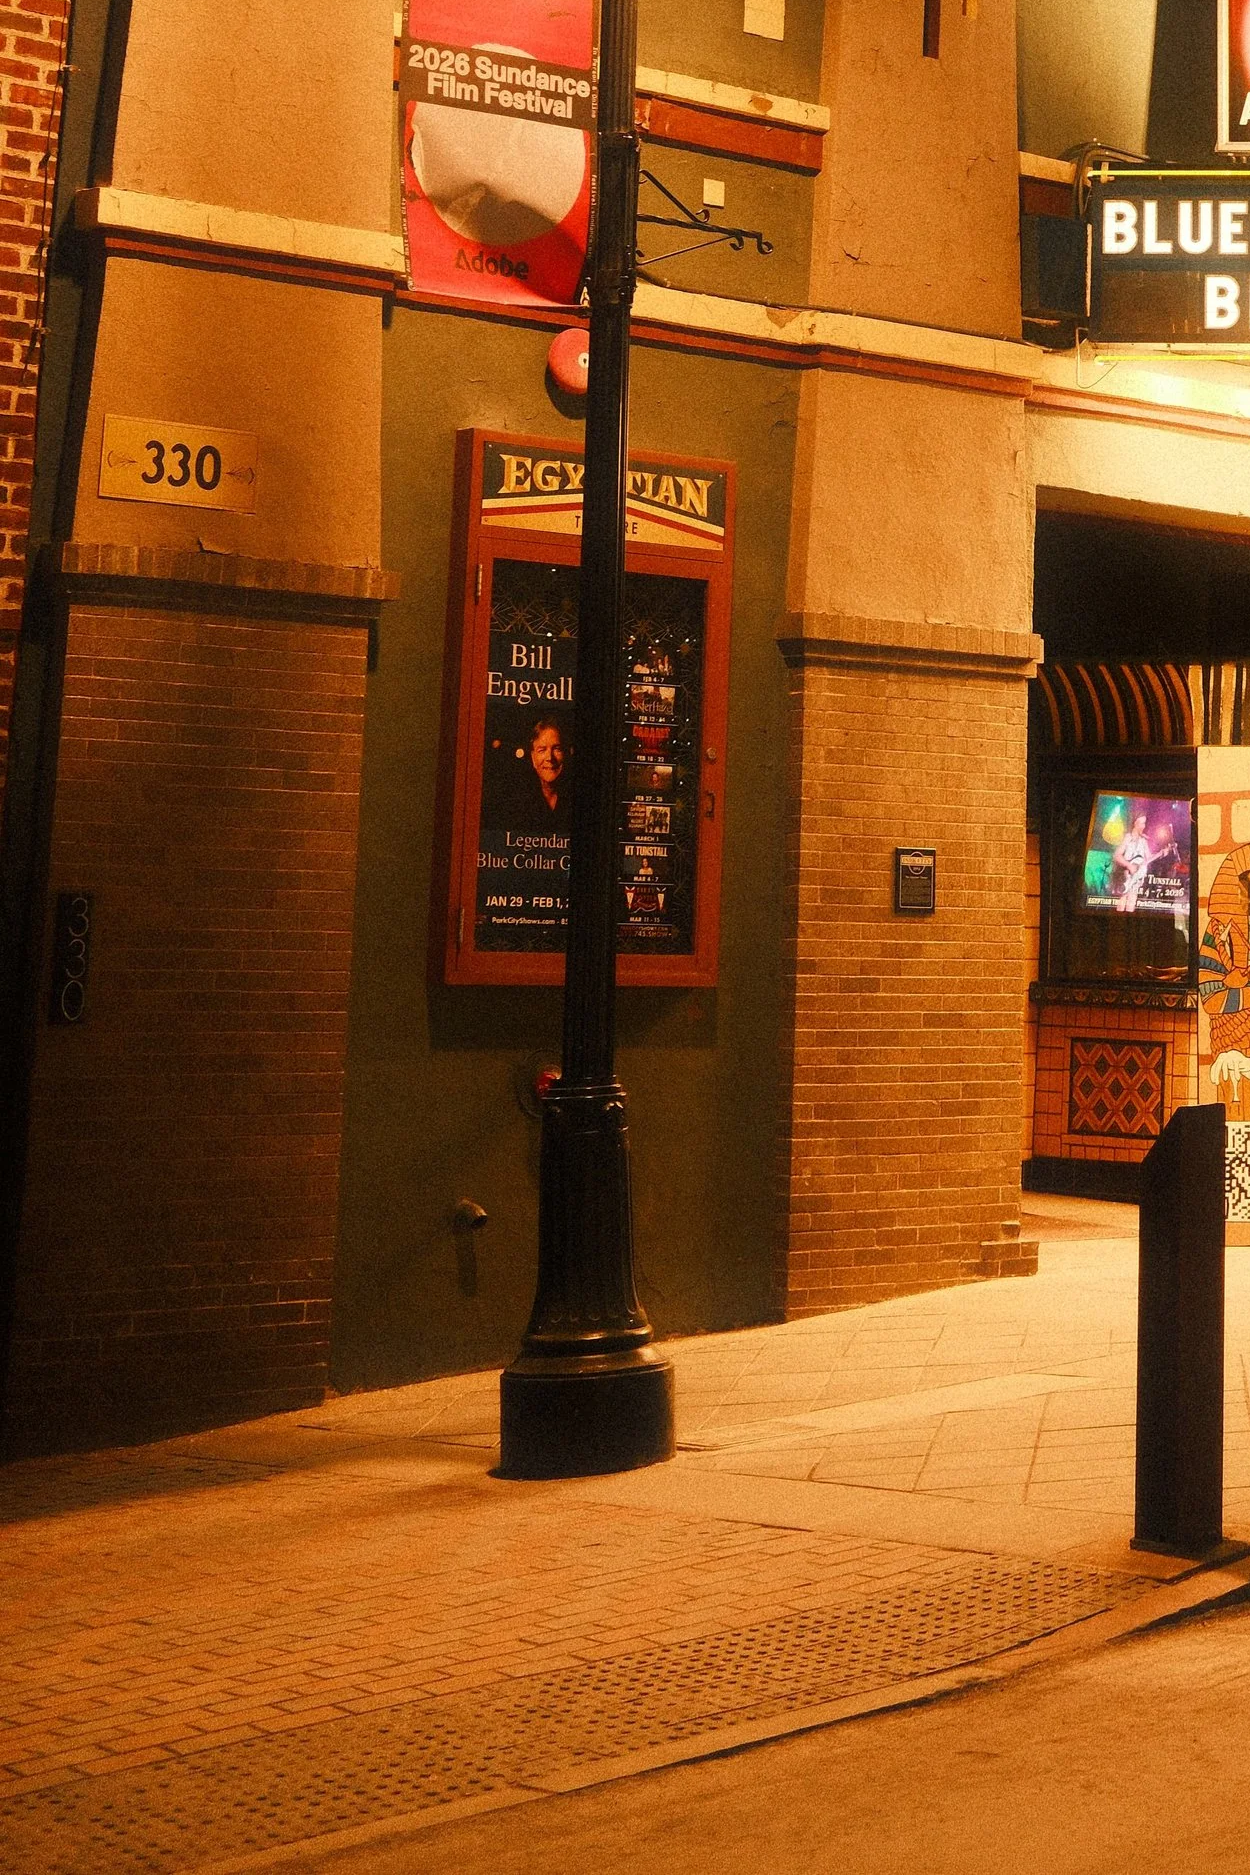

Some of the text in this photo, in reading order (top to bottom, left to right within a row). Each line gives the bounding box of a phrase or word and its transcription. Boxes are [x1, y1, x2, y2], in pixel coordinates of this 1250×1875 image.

[408, 44, 591, 98] 2026 Sundance
[427, 72, 573, 119] Film Festival
[1102, 199, 1249, 255] BLUE
[455, 247, 529, 280] Adobe
[141, 439, 222, 491] 330
[498, 453, 714, 517] EGYTIAN
[510, 643, 552, 670] Bill
[486, 671, 573, 705] Engvall
[506, 831, 571, 852] Legendar
[636, 845, 668, 857] TUNSTALL
[477, 852, 509, 868] Blue
[513, 853, 557, 870] Collar
[485, 896, 507, 907] JAN
[510, 896, 523, 907] 29
[532, 896, 553, 908] FEB
[556, 898, 563, 909] 1,
[1165, 887, 1185, 897] 2026
[491, 916, 555, 926] ParkCityShows.com
[62, 897, 88, 1020] 330
